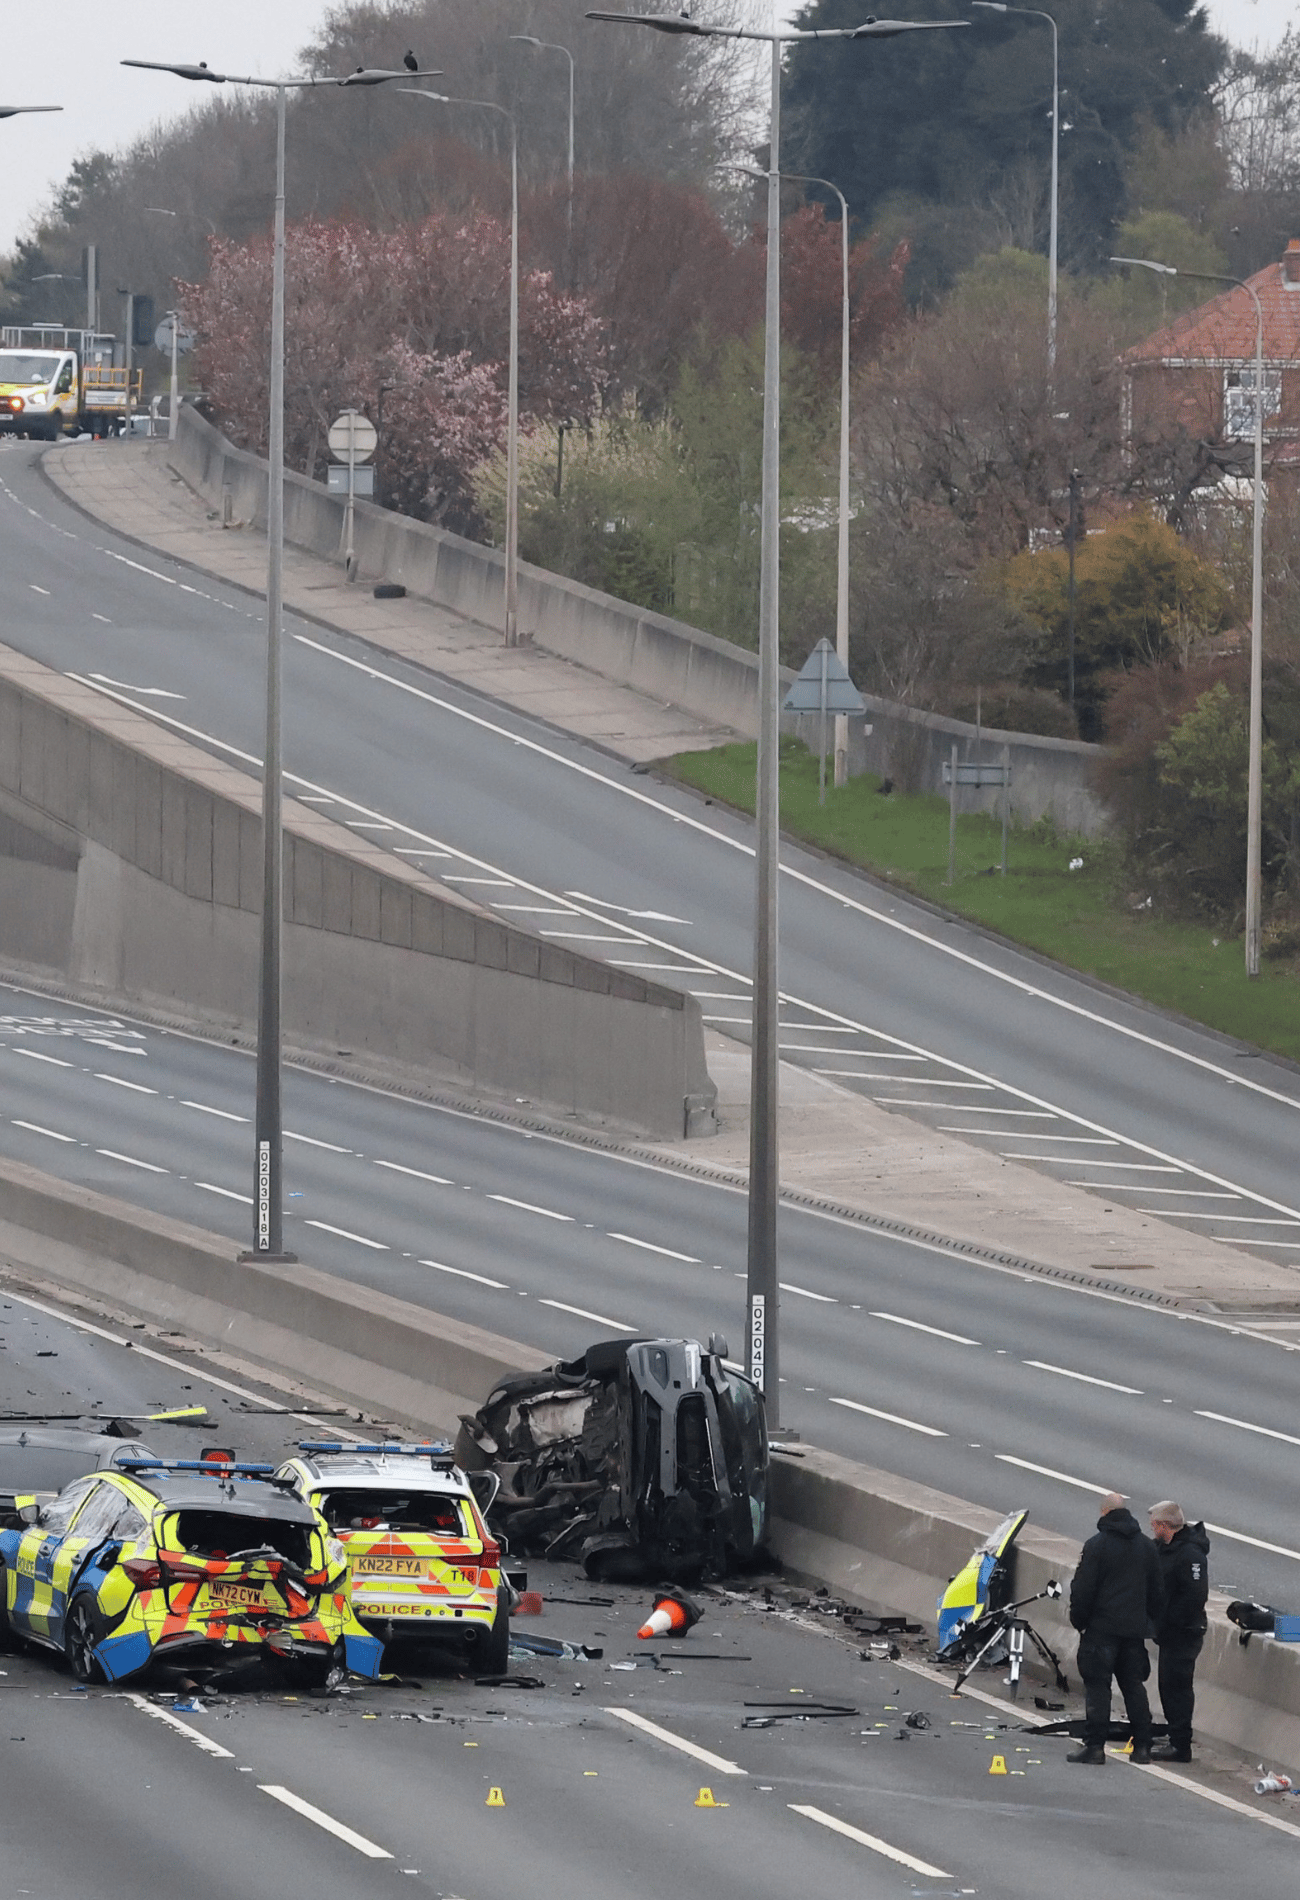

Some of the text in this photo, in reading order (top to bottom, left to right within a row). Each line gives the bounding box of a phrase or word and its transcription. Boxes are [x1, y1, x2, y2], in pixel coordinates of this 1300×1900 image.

[17, 1556, 35, 1577] POLICE
[358, 1558, 421, 1573] KN22 FYA
[358, 1604, 421, 1615] POLICE
